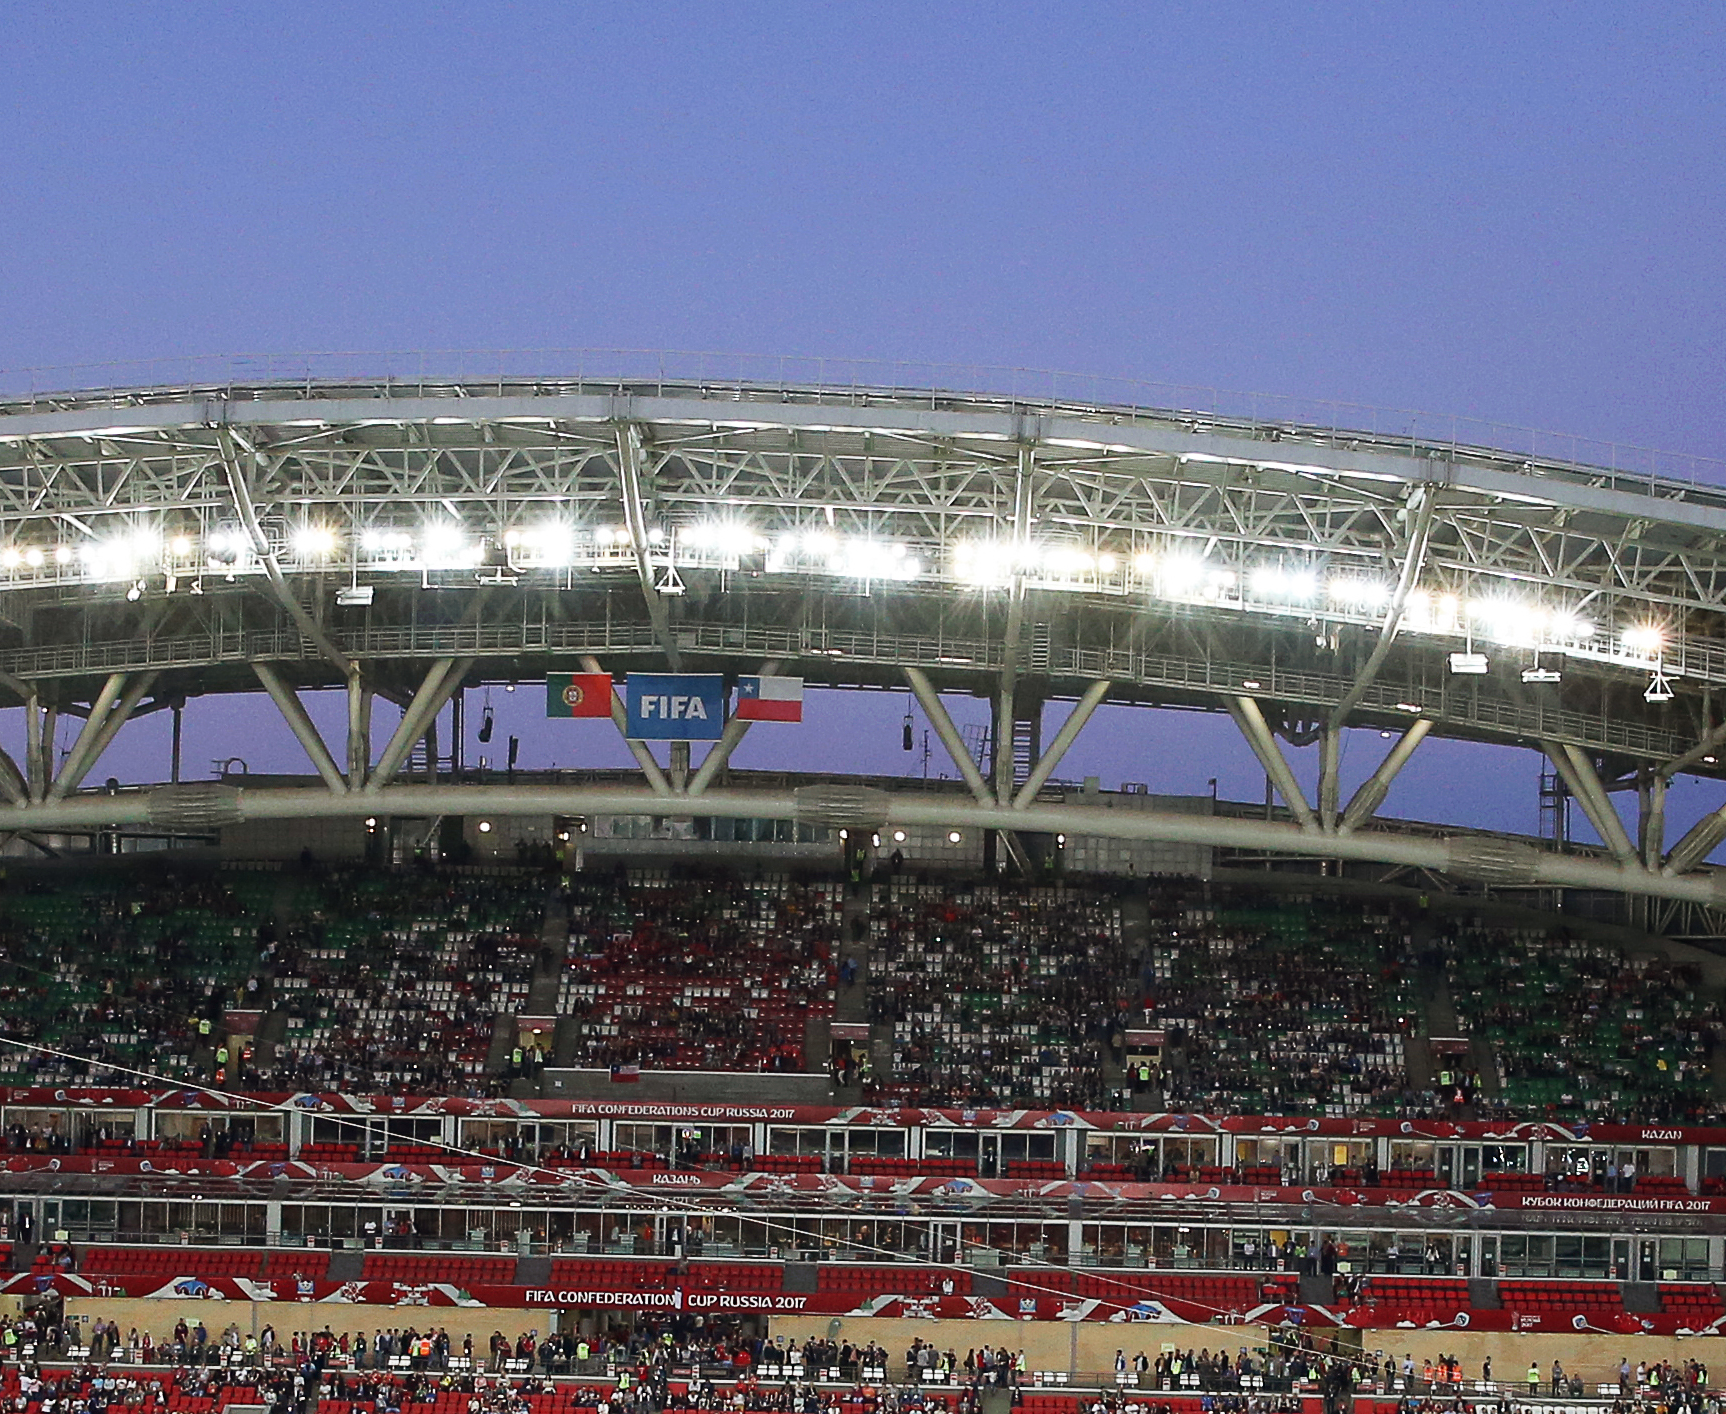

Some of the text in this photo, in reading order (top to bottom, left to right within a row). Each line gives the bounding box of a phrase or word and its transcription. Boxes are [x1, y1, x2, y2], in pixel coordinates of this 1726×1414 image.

[640, 695, 708, 720] FIFA
[572, 1104, 795, 1119] FIFA CONFEDERATIONS CUP RUSSIA 2017
[1642, 1129, 1683, 1140] KAZAN
[653, 1174, 701, 1185] КАЗАНЬ
[1522, 1196, 1711, 1211] КУБОК КОНФЕДЕРАЦИЙ FIFA 2017
[525, 1290, 807, 1309] FIFA CONFEDERATION CUP RUSSIA 2017
